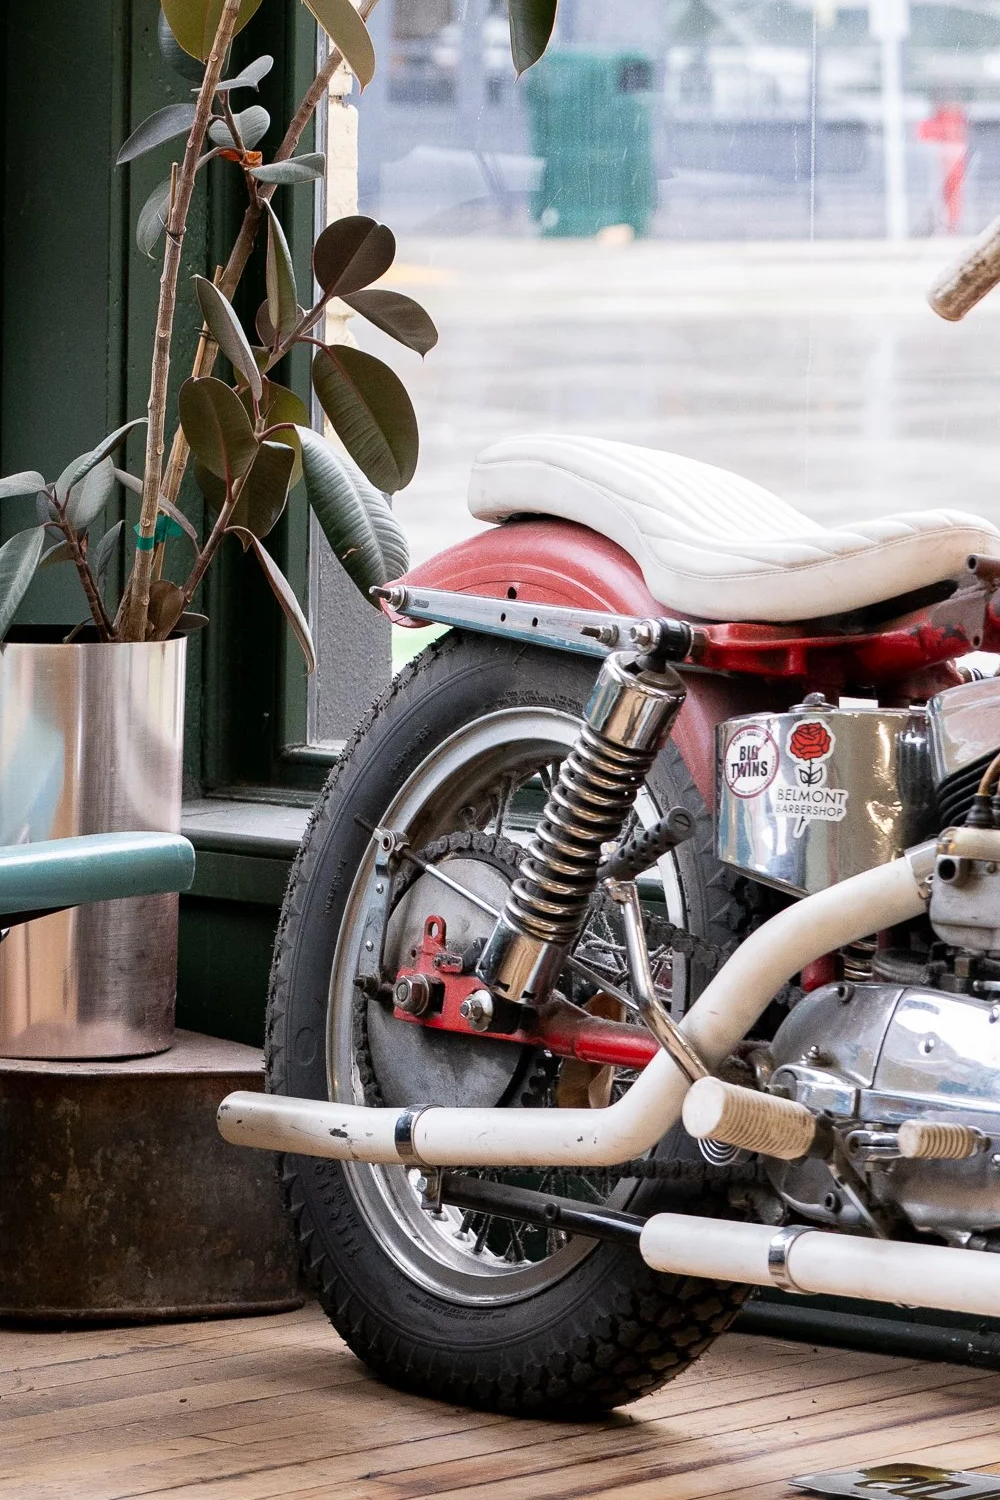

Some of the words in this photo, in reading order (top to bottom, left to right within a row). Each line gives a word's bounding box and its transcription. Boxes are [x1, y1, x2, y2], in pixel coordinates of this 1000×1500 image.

[740, 745, 759, 761] BIG
[731, 760, 768, 778] TWINS
[777, 788, 845, 805] BELMONT
[775, 803, 843, 817] BARBERSHOP
